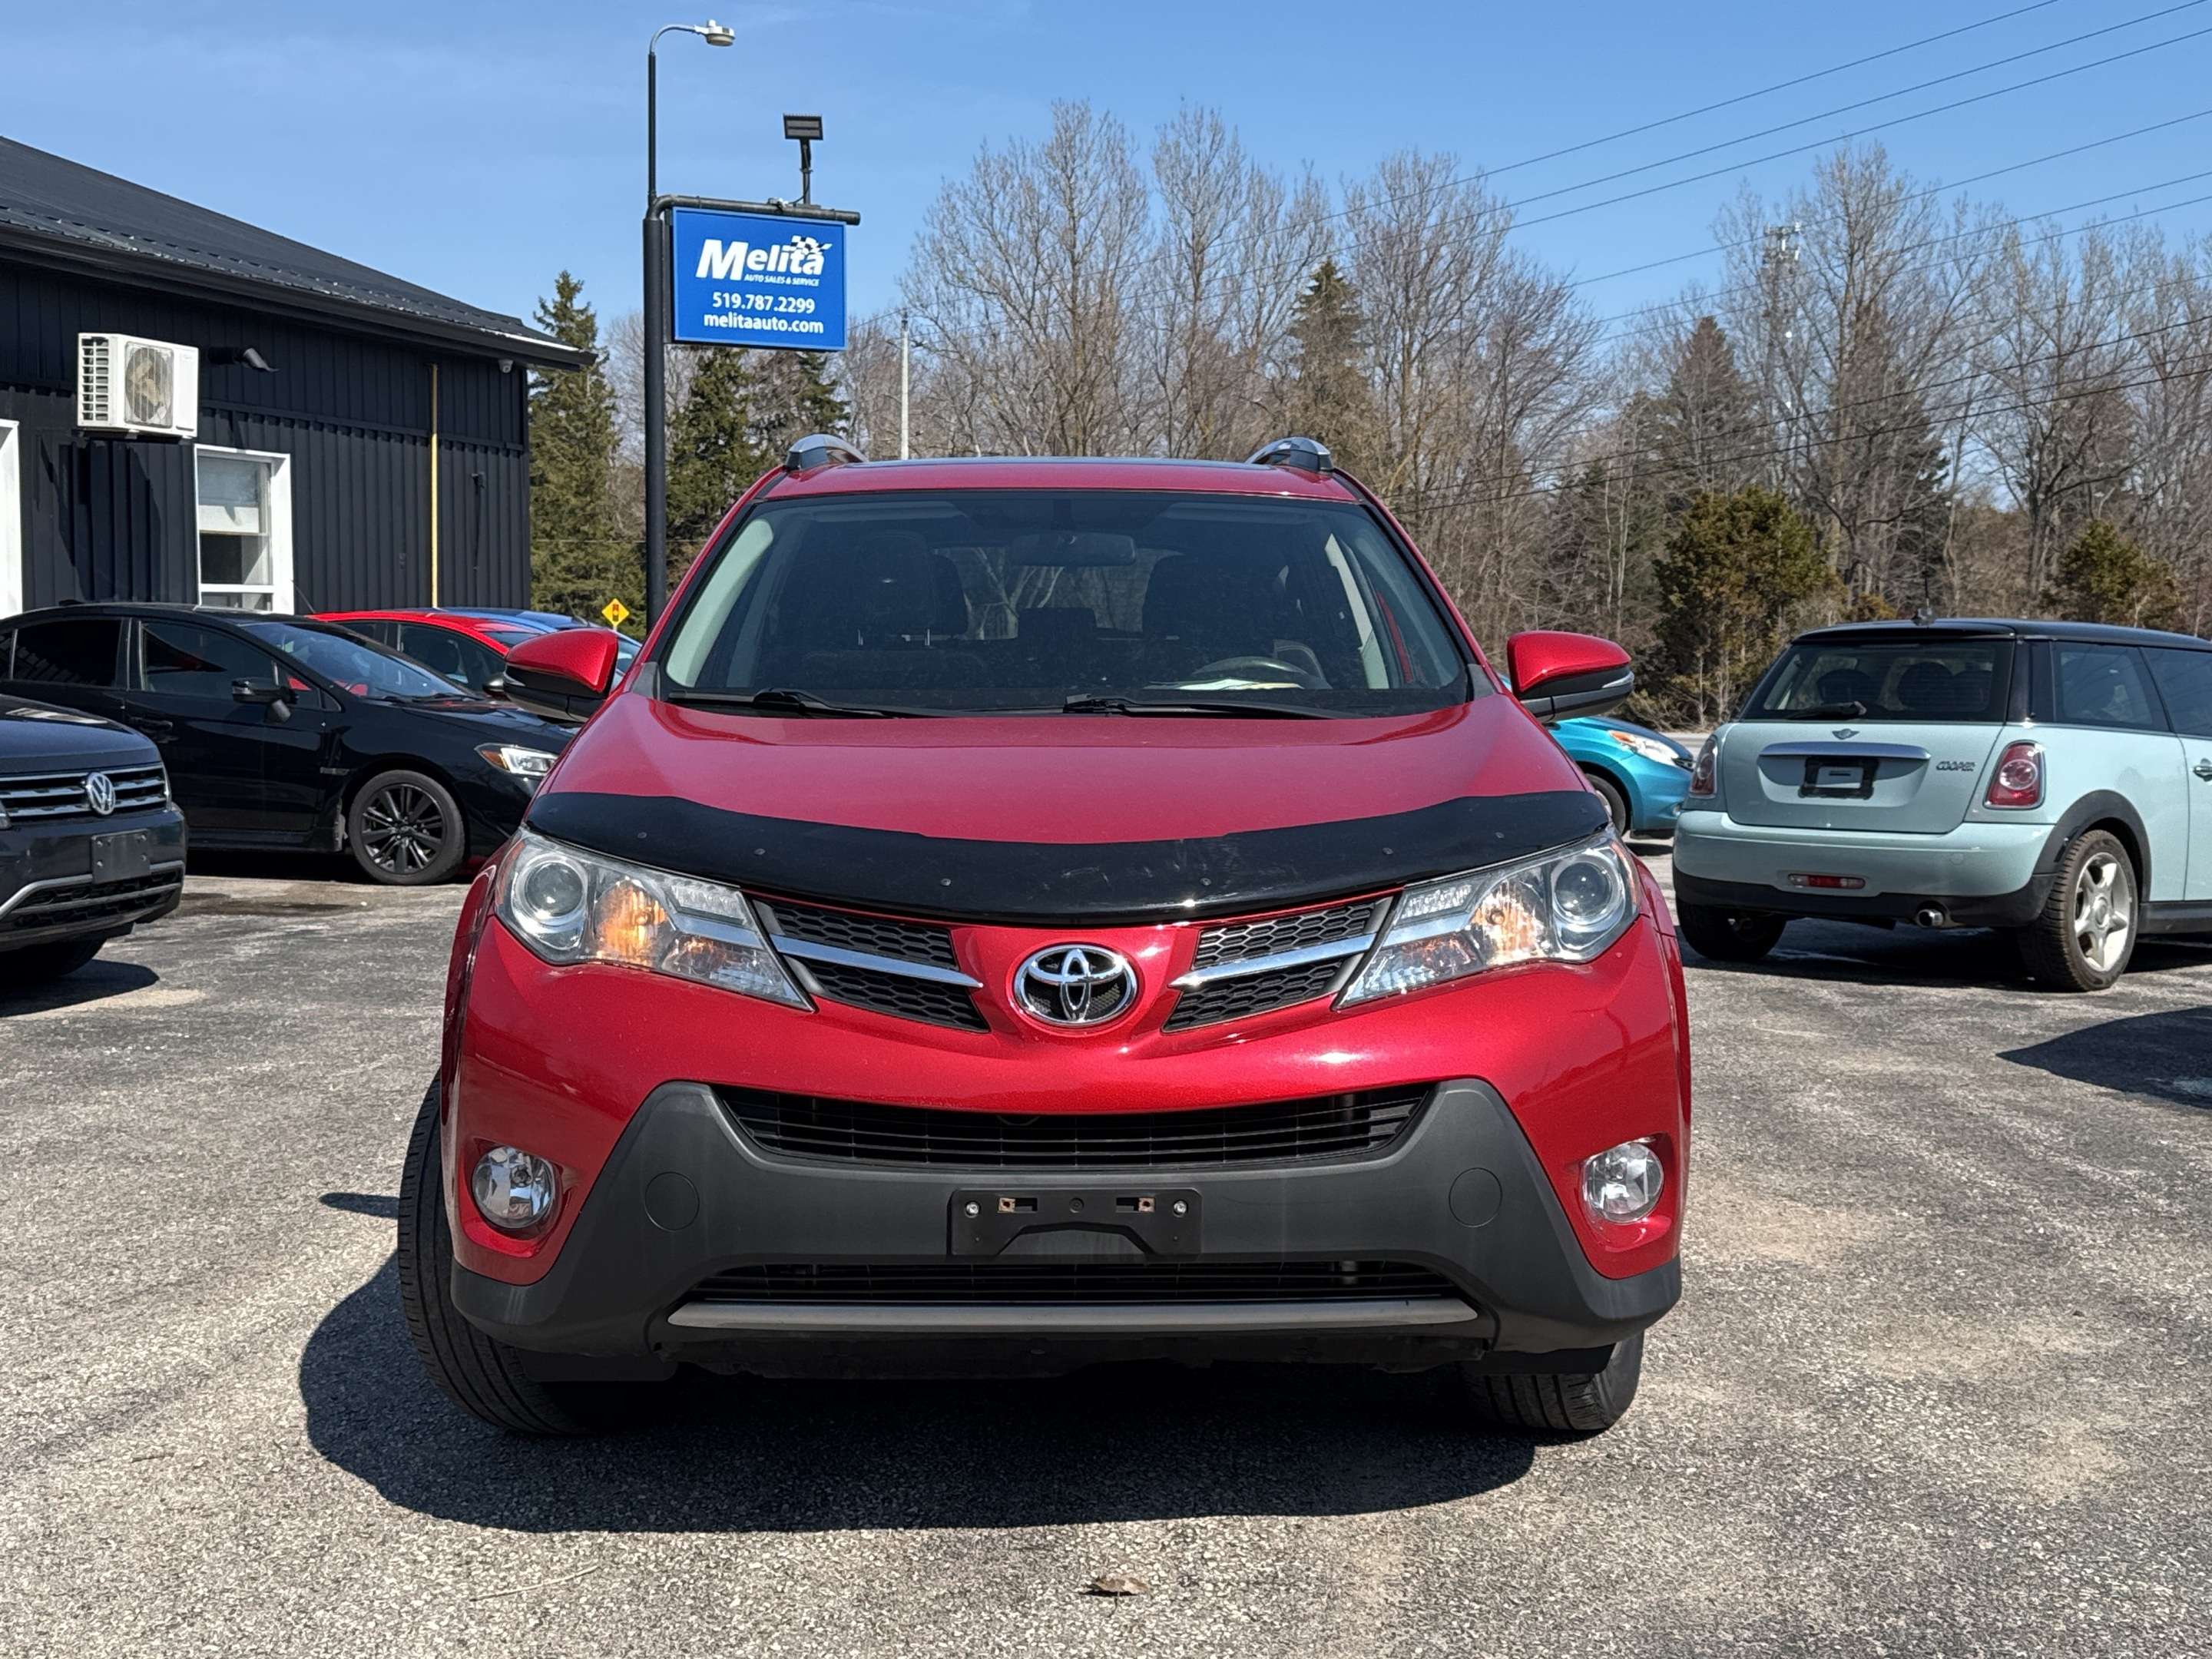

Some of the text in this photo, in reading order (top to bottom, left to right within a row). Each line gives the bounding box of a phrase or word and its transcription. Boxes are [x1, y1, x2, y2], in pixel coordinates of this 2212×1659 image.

[695, 238, 826, 281] Melita
[743, 273, 765, 283] AUTO
[764, 275, 785, 284] SALES
[791, 277, 820, 287] SERVICE
[712, 292, 815, 313] 519.787.2299
[704, 312, 823, 333] melitaauto.com
